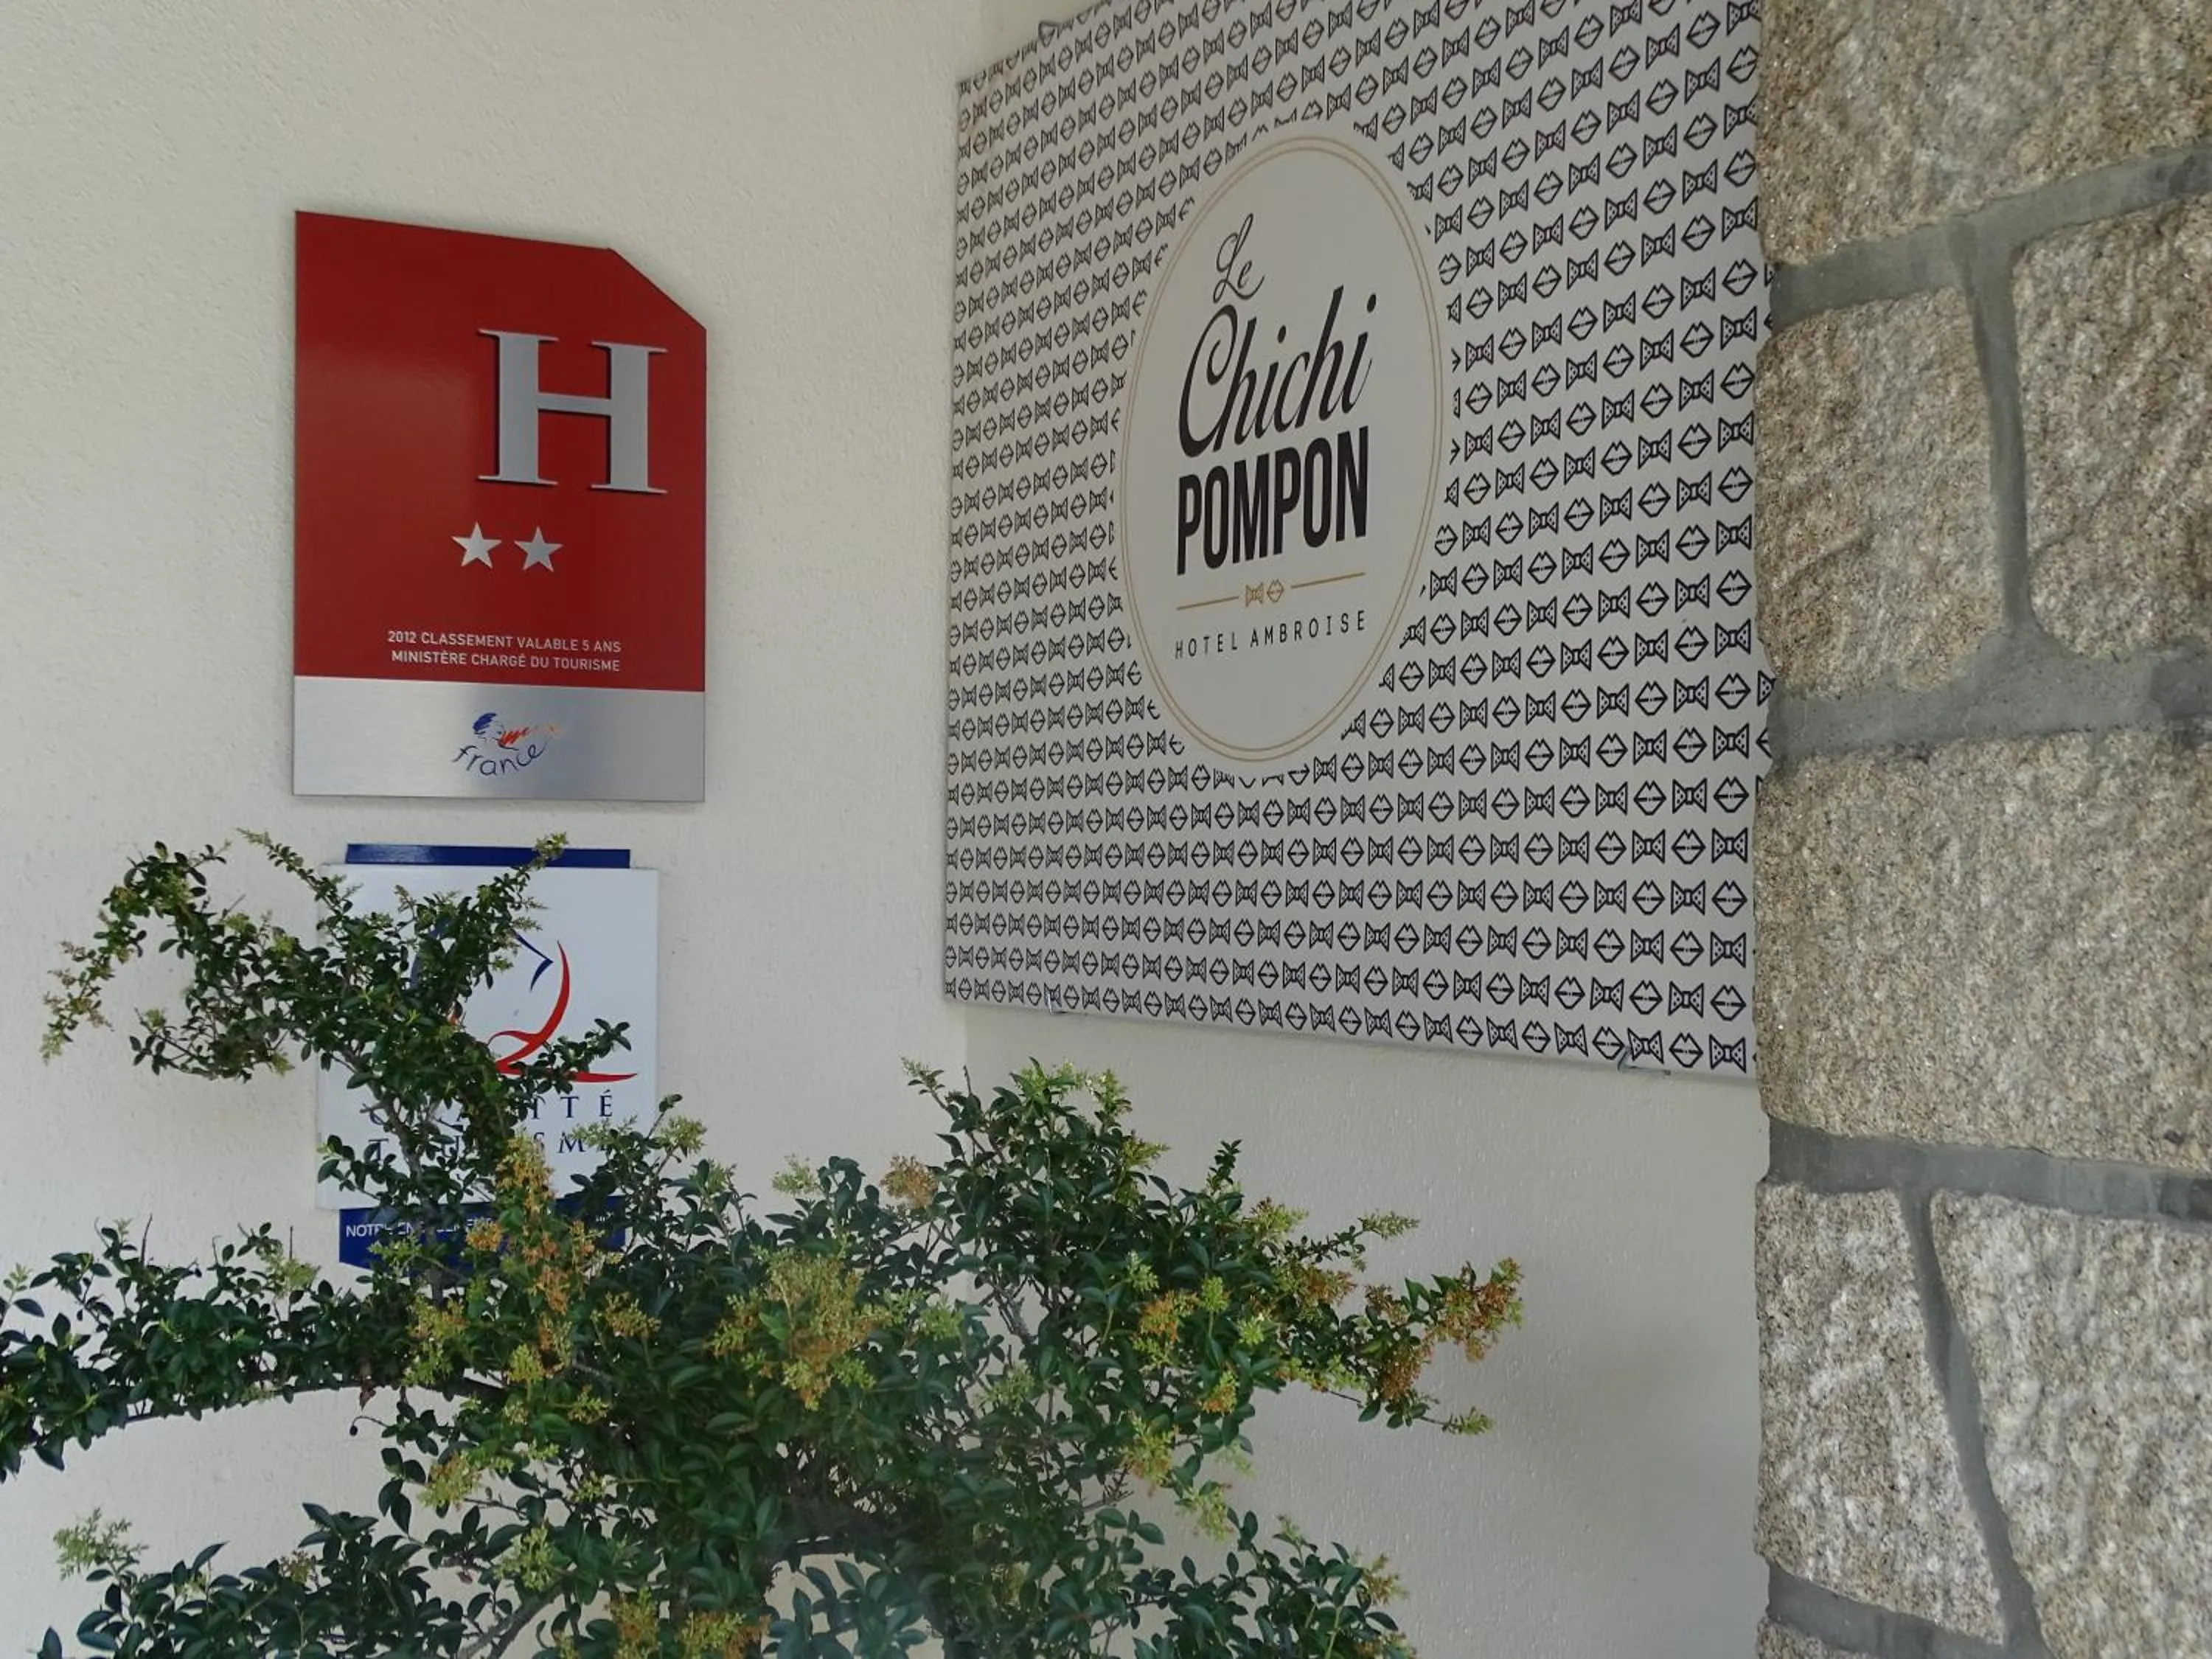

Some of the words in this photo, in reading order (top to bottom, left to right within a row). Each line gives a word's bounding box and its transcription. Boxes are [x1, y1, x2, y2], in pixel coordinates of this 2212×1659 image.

[1213, 212, 1265, 304] Le
[478, 327, 668, 494] H
[1179, 285, 1377, 458] Chichi
[1177, 425, 1369, 576] POMPON
[388, 630, 417, 644] 2012
[421, 631, 513, 647] CLASSEMENT
[517, 636, 579, 651] VALABLE
[582, 639, 590, 652] 5
[594, 640, 622, 653] ANS
[392, 650, 467, 664] MINISTÈRE
[471, 653, 526, 668] CHARGÉ
[530, 655, 550, 668] DU
[552, 657, 620, 672] TOURISME
[1175, 631, 1238, 659] HOTEL
[1250, 610, 1365, 647] AMBROISE
